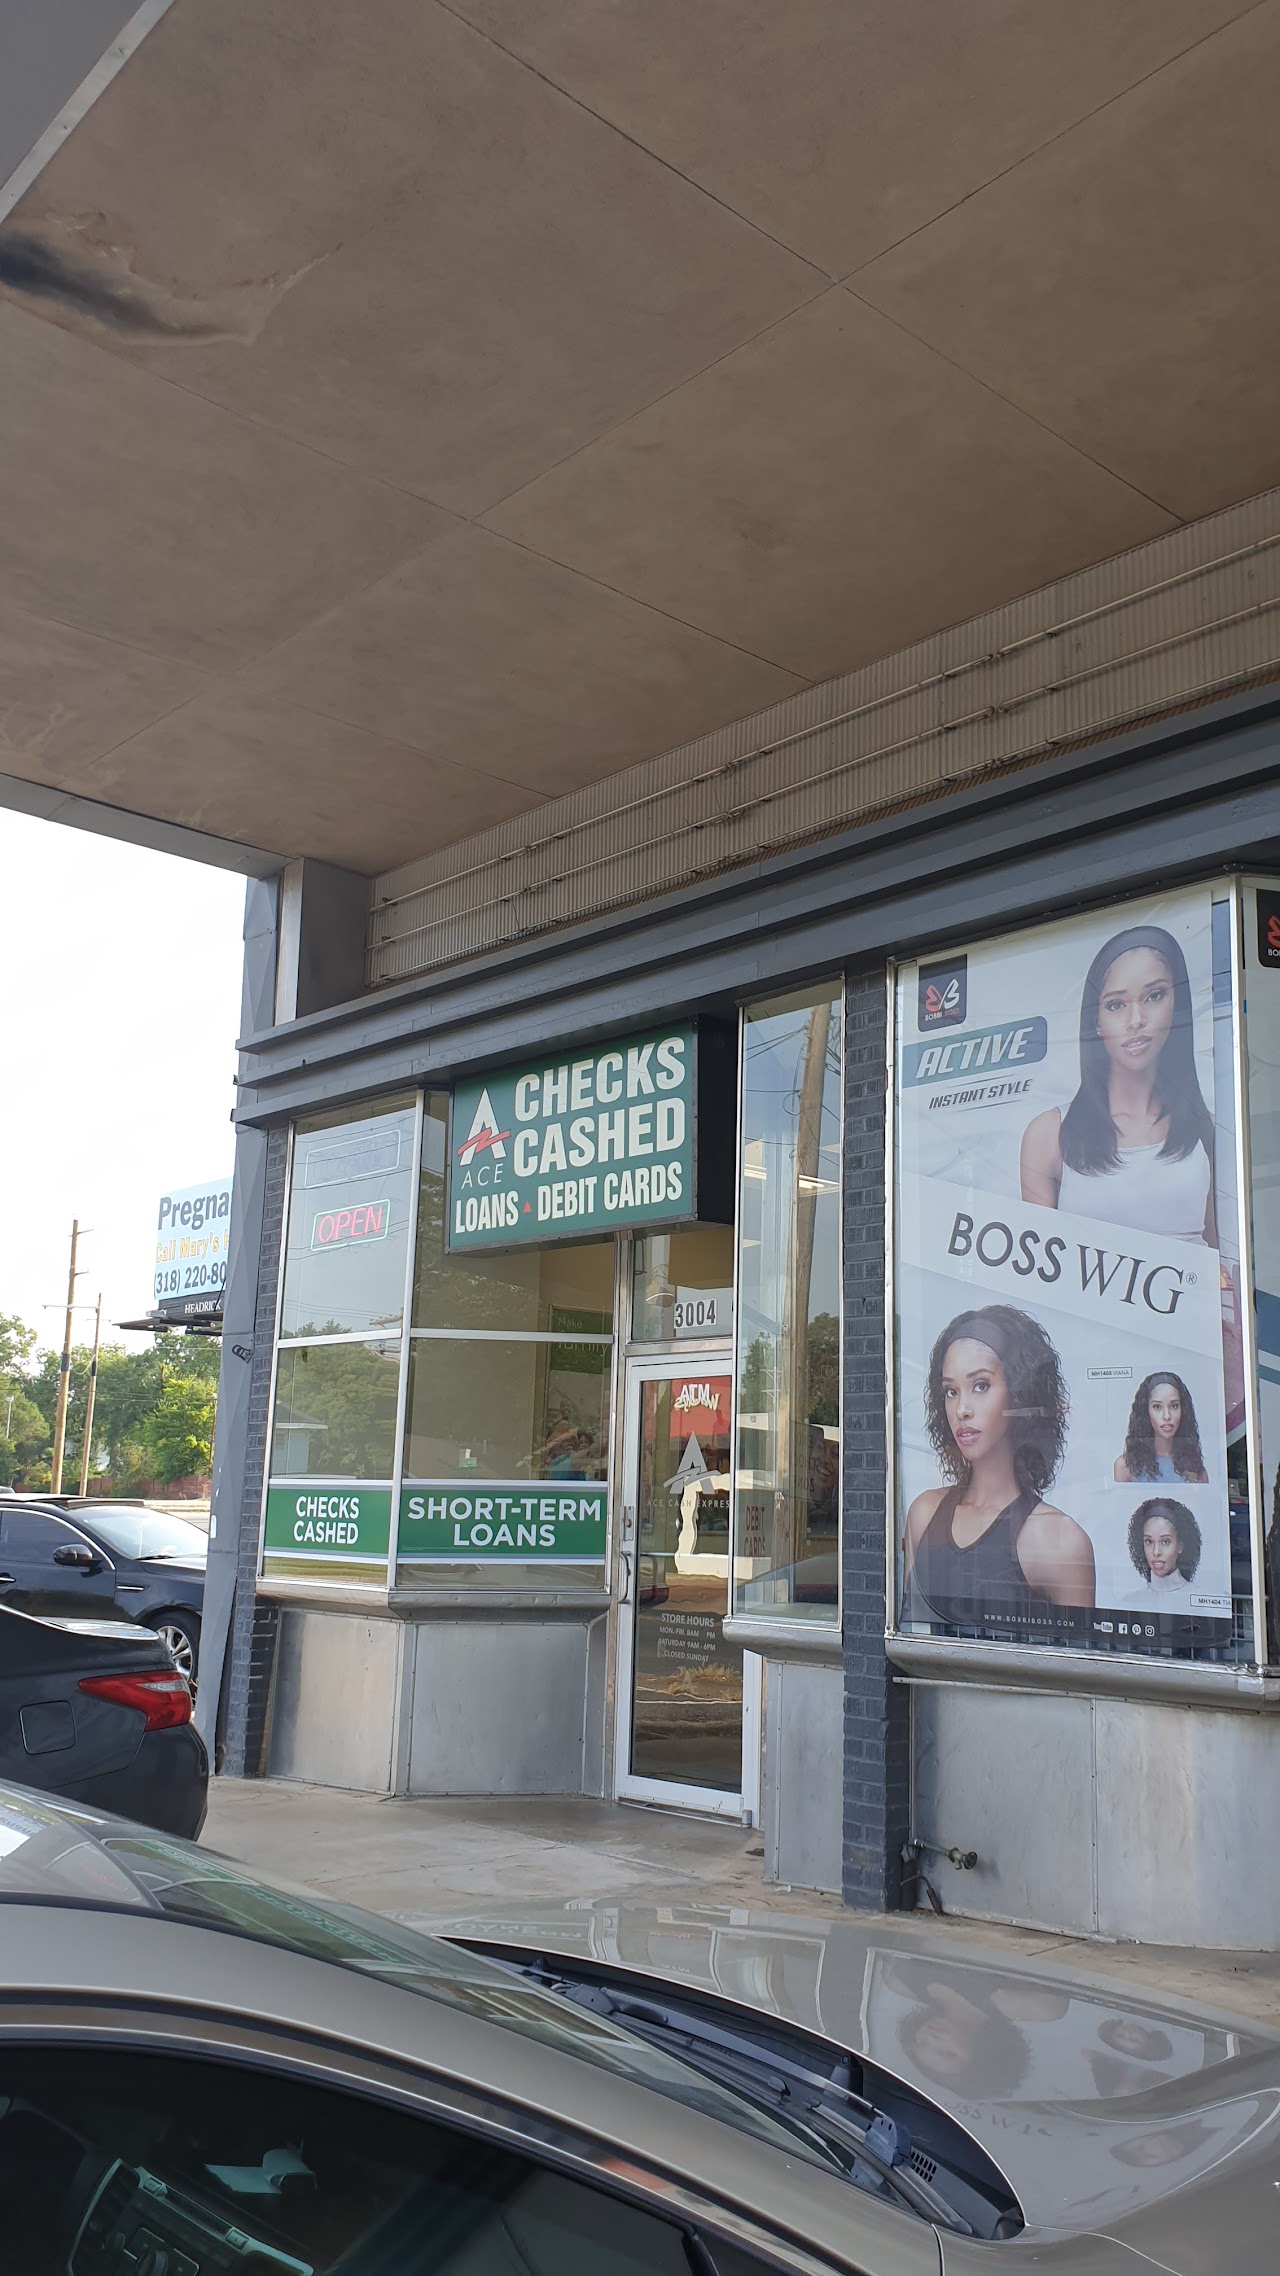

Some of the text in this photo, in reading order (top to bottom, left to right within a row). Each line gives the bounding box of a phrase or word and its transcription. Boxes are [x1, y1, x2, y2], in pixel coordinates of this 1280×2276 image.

[925, 1008, 959, 1021] BOBBI BOSS
[915, 1026, 1034, 1079] ACTIVE
[515, 1036, 686, 1123] CHECKS
[928, 1078, 1033, 1110] INSTANT STYLE
[513, 1097, 686, 1178] CASHED
[461, 1163, 504, 1190] ACE
[455, 1161, 683, 1234] LOANS DEBIT CARDS
[317, 1205, 383, 1243] OPEN
[156, 1240, 176, 1264] Call
[180, 1231, 219, 1260] Mary's
[947, 1211, 1067, 1283] BOSS
[154, 1268, 181, 1298] (318)
[675, 1299, 716, 1328] 3004
[295, 1495, 361, 1519] CHECKS
[407, 1496, 602, 1522] SHORT-TERM
[647, 1497, 664, 1507] ACE
[668, 1498, 692, 1508] CASH
[293, 1520, 360, 1545] CASHED
[453, 1523, 556, 1547] LOANS
[661, 1612, 715, 1628] STORE HOURS
[686, 1629, 700, 1637] 8AM
[983, 1614, 1076, 1627] WWW.BOBBIBOSS.COM
[663, 1650, 710, 1662] CLOSED SUNDAY
[686, 1641, 700, 1649] 9AM
